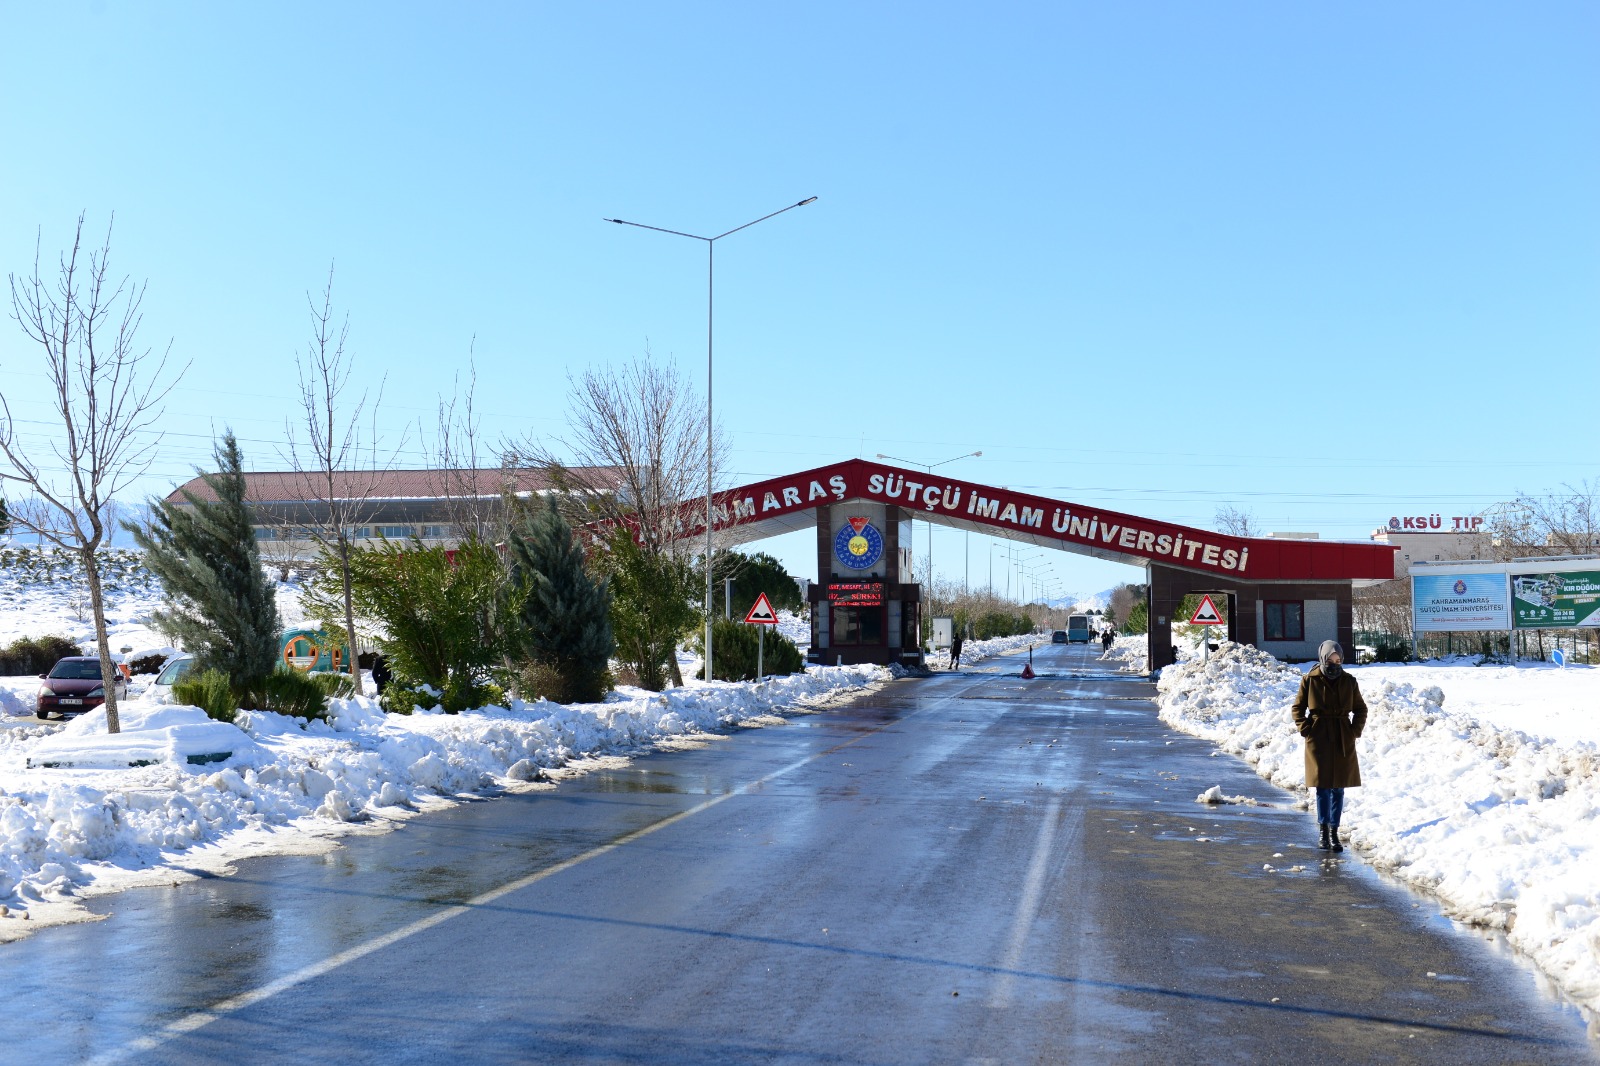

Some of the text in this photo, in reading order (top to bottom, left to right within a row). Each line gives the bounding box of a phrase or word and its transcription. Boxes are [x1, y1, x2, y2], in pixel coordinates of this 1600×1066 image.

[867, 472, 961, 511] SÜTÇÜ
[967, 490, 1044, 529] İMAM
[1051, 508, 1250, 573] ÜNİVERSİTESİ
[1403, 514, 1484, 529] KSÜ TIP
[1431, 597, 1490, 605] KAHRAMANMARAŞ
[1419, 605, 1440, 614] SÜTÇÜ
[1460, 604, 1504, 612] ÜNİVERSİTESİ
